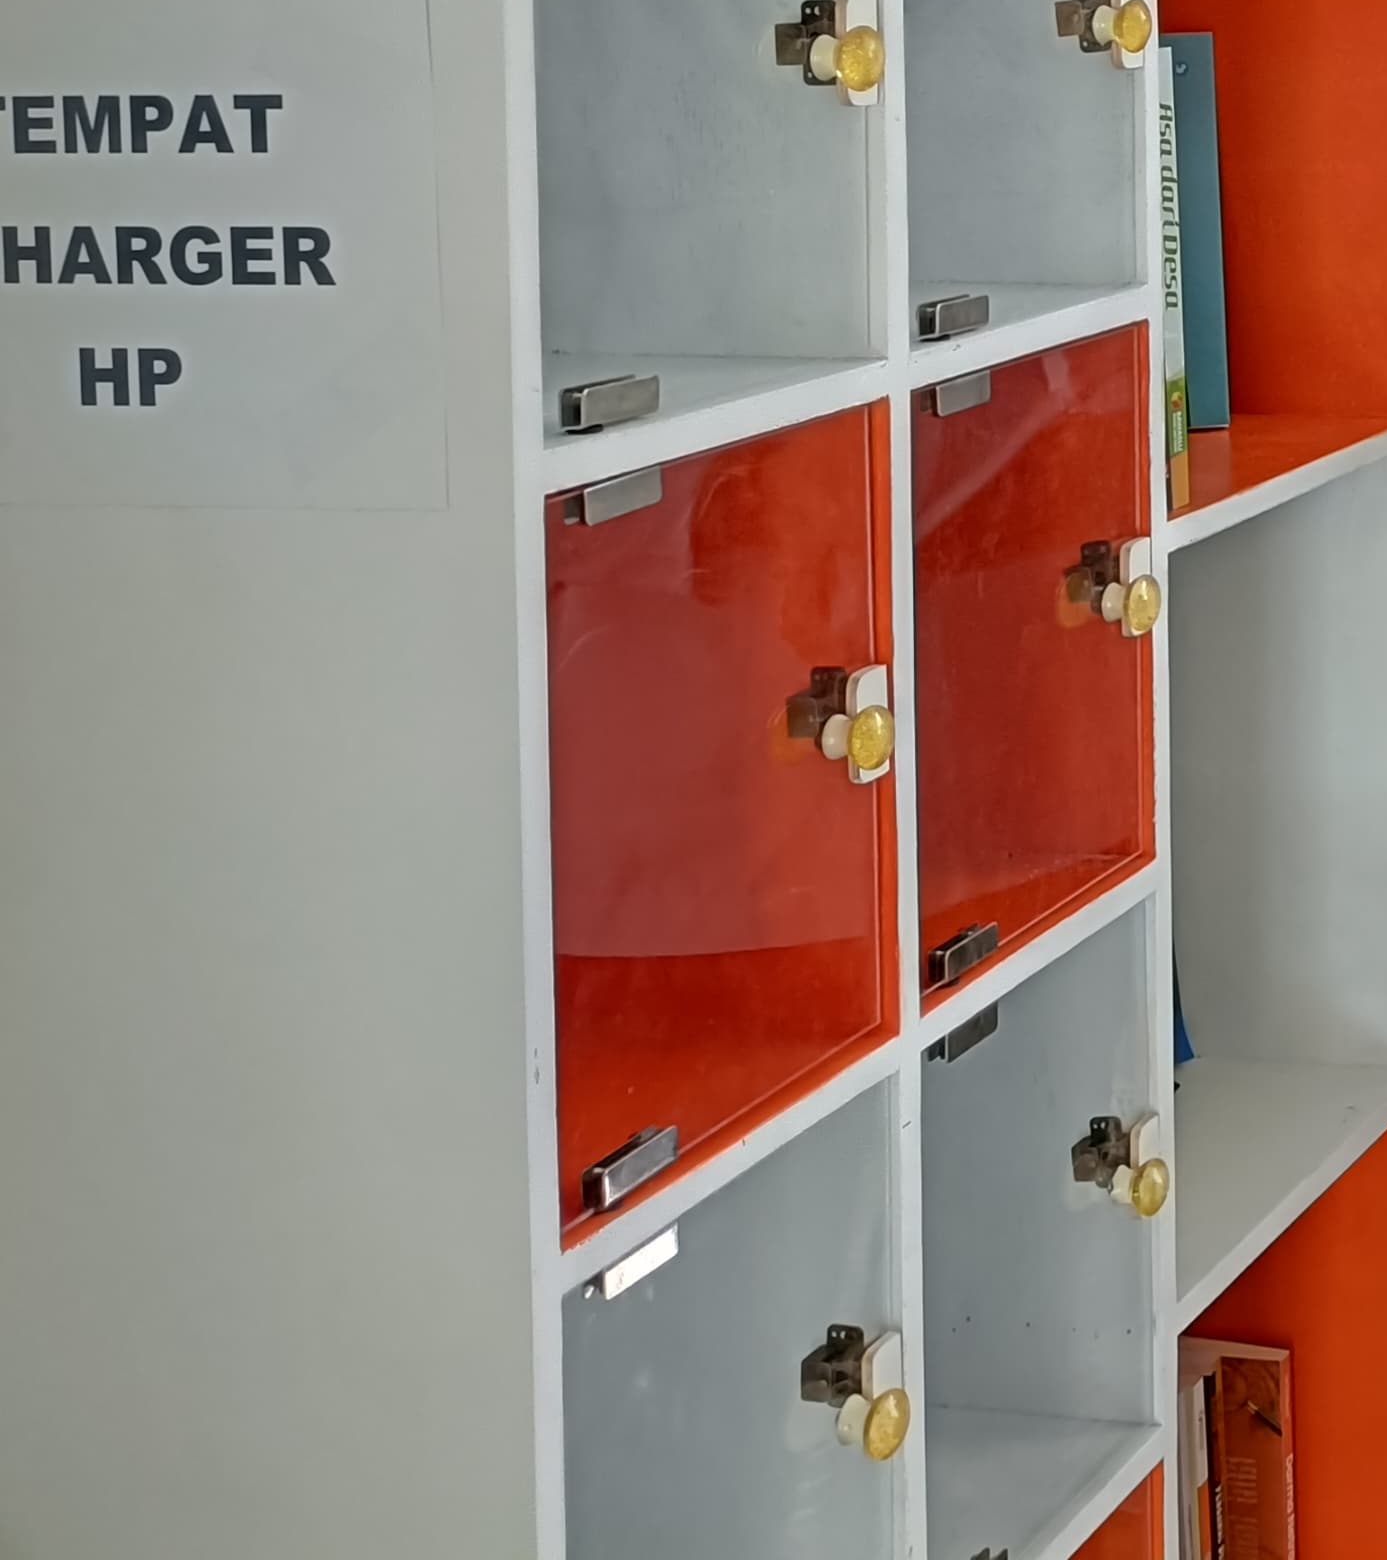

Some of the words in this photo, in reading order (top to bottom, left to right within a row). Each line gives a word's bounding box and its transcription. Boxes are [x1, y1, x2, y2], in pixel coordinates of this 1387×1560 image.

[0, 95, 283, 154] EMPAT
[1157, 102, 1174, 158] Asa
[1159, 164, 1179, 229] dari
[1161, 233, 1180, 310] Desa
[78, 347, 183, 407] HP
